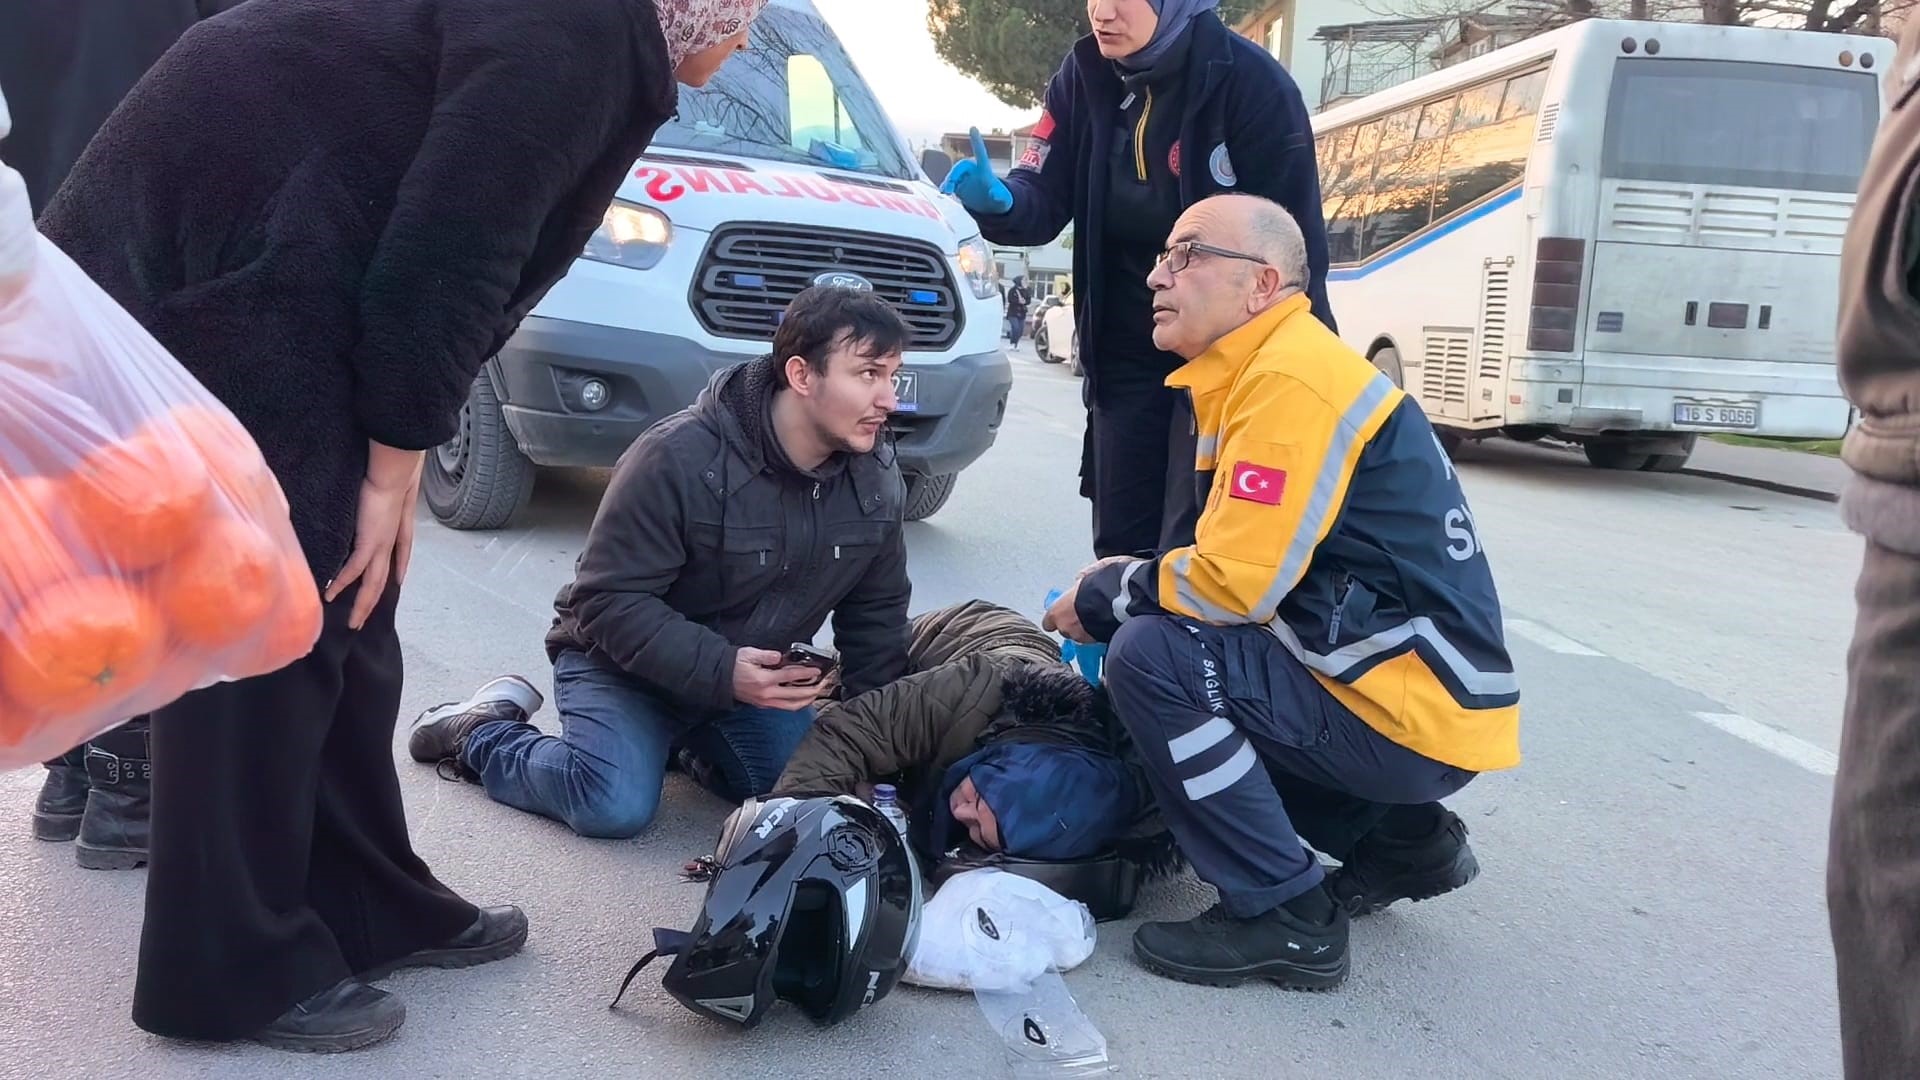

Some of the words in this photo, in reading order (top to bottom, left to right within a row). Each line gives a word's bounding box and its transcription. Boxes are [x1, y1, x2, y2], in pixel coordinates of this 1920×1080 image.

[1686, 407, 1700, 420] 16
[1705, 408, 1714, 421] S
[1203, 659, 1225, 712] SAĞLIK
